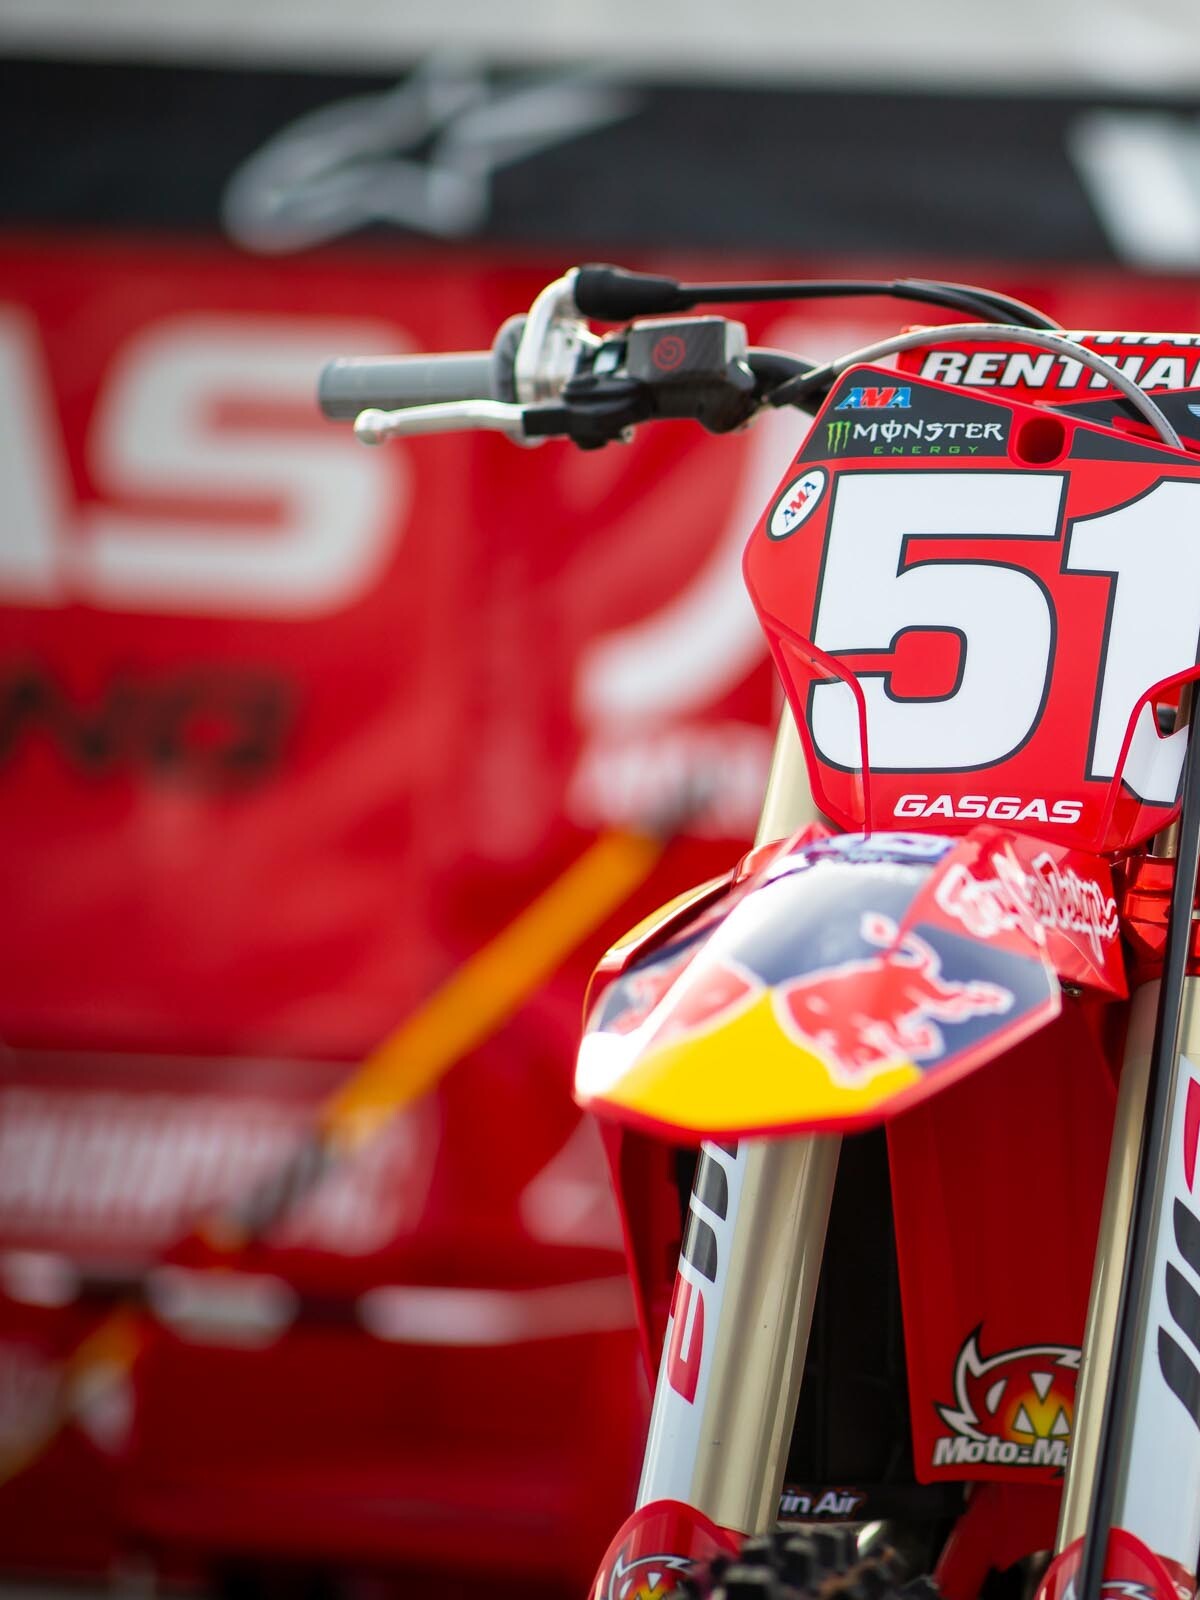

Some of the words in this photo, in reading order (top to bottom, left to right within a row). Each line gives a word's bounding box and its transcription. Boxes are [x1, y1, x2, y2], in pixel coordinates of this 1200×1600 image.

[833, 386, 913, 411] AMA
[872, 445, 980, 455] ENERGY
[782, 480, 818, 528] AMA
[892, 793, 1084, 824] GASGAS
[931, 1435, 1068, 1467] Moto-M
[779, 1489, 812, 1514] in
[812, 1490, 862, 1515] Air
